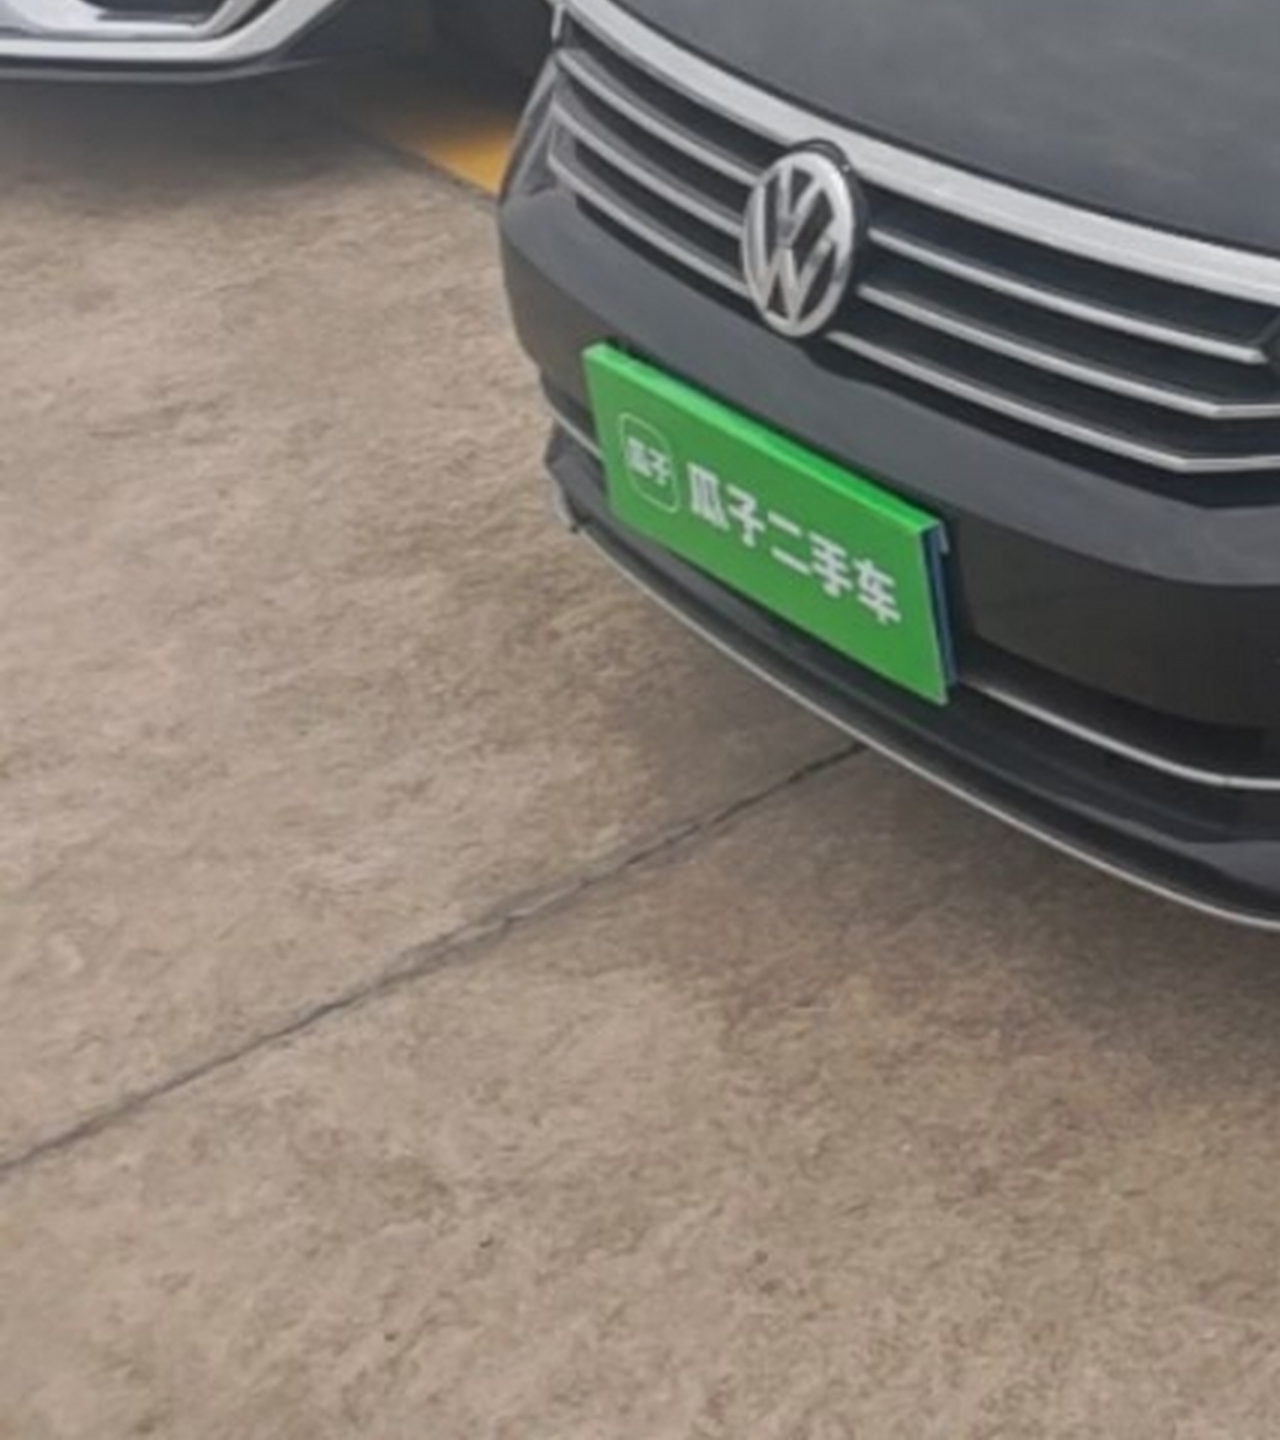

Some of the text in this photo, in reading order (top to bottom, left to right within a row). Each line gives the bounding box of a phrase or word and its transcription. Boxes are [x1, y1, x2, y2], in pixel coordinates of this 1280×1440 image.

[687, 460, 902, 626] 瓜子二手车
